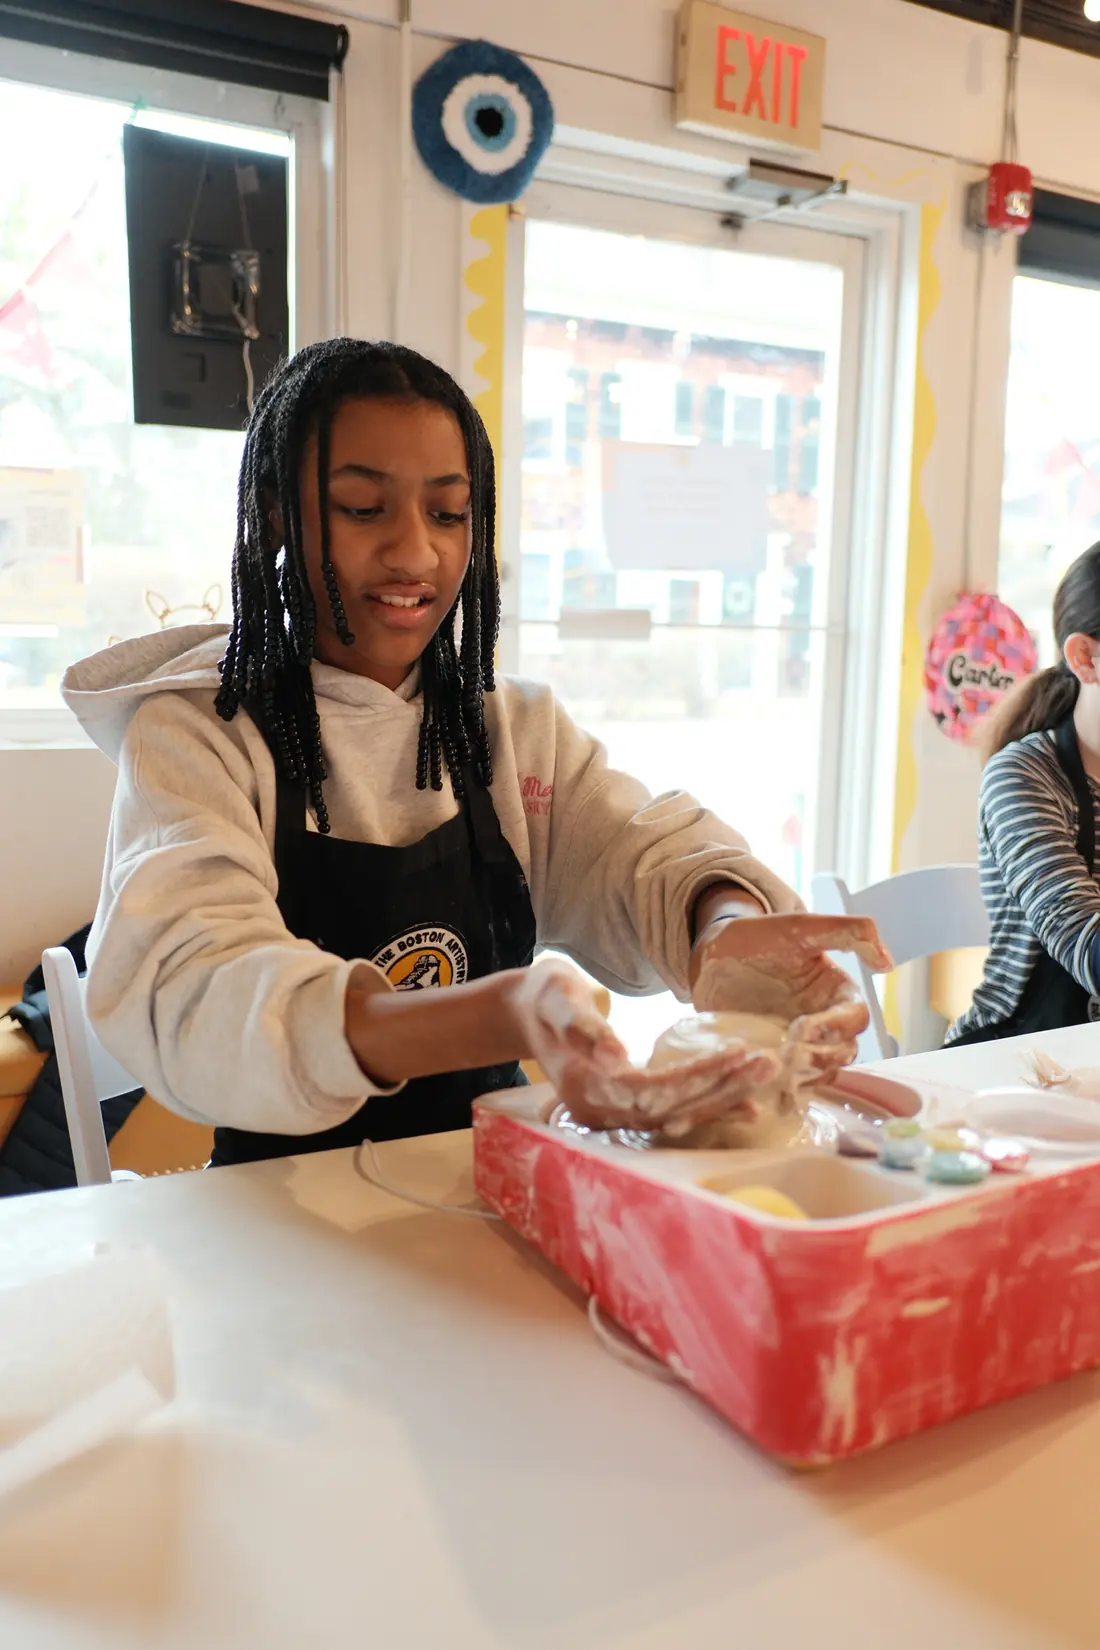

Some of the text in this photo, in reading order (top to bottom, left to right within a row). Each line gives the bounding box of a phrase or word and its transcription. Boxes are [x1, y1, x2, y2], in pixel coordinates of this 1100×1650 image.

[715, 24, 808, 128] EXIT
[375, 948, 395, 968] THE
[397, 931, 446, 952] BOSTON
